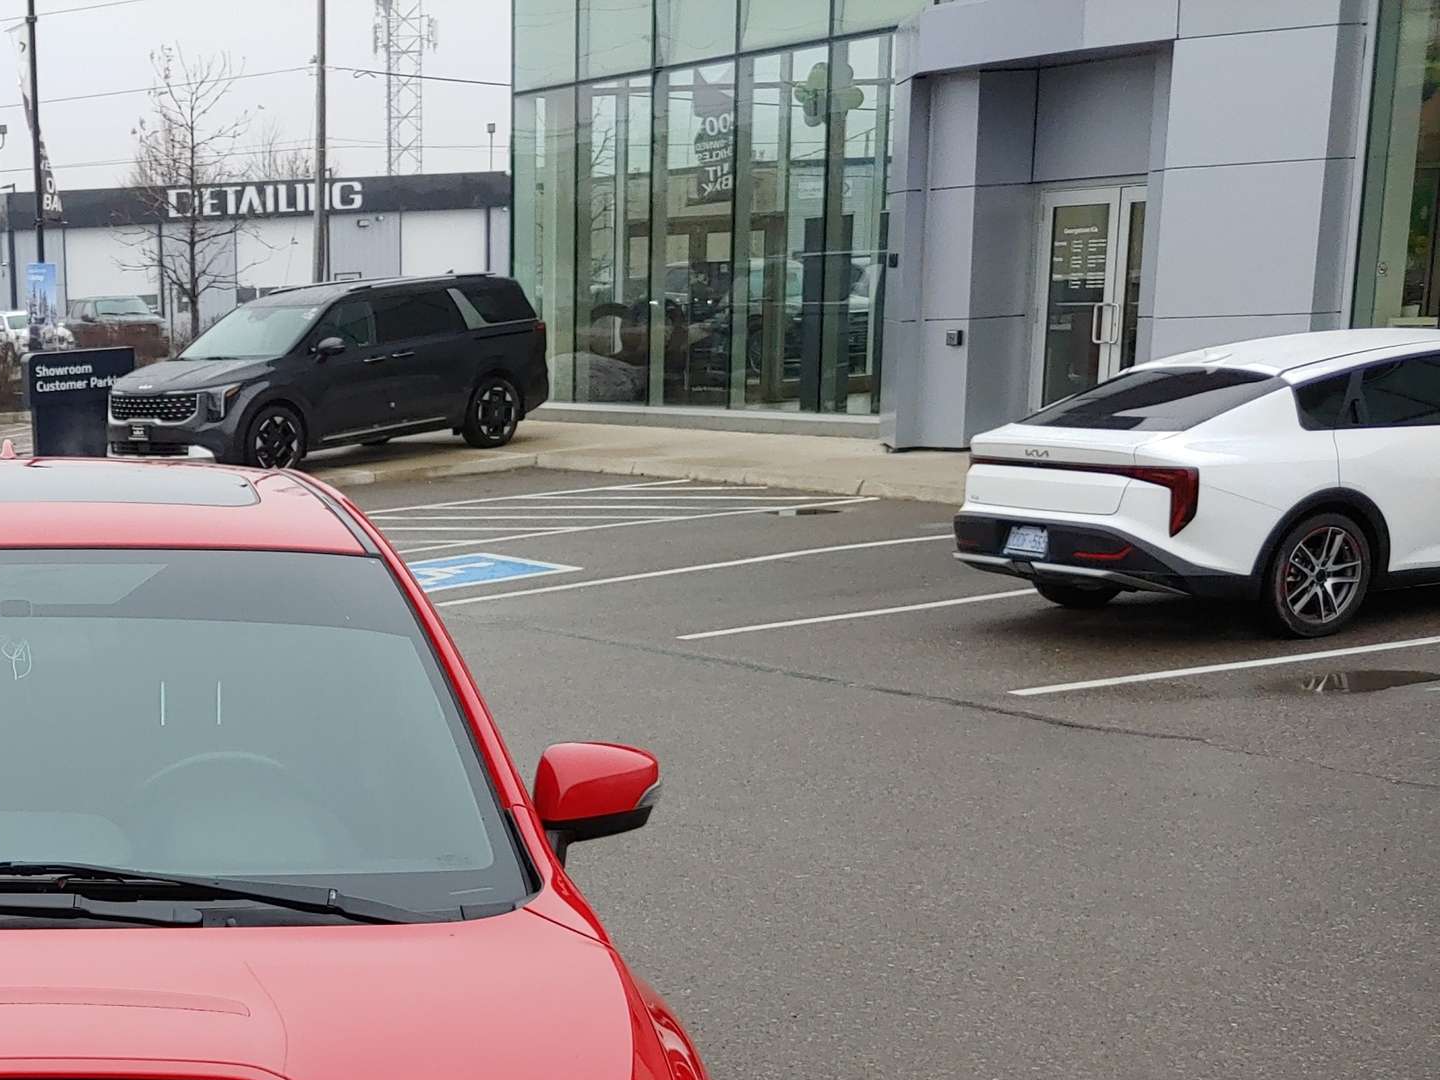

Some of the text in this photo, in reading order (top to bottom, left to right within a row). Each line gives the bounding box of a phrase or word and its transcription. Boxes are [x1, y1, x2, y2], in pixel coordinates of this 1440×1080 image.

[35, 364, 93, 378] Showroom
[36, 375, 121, 393] Customer Parki
